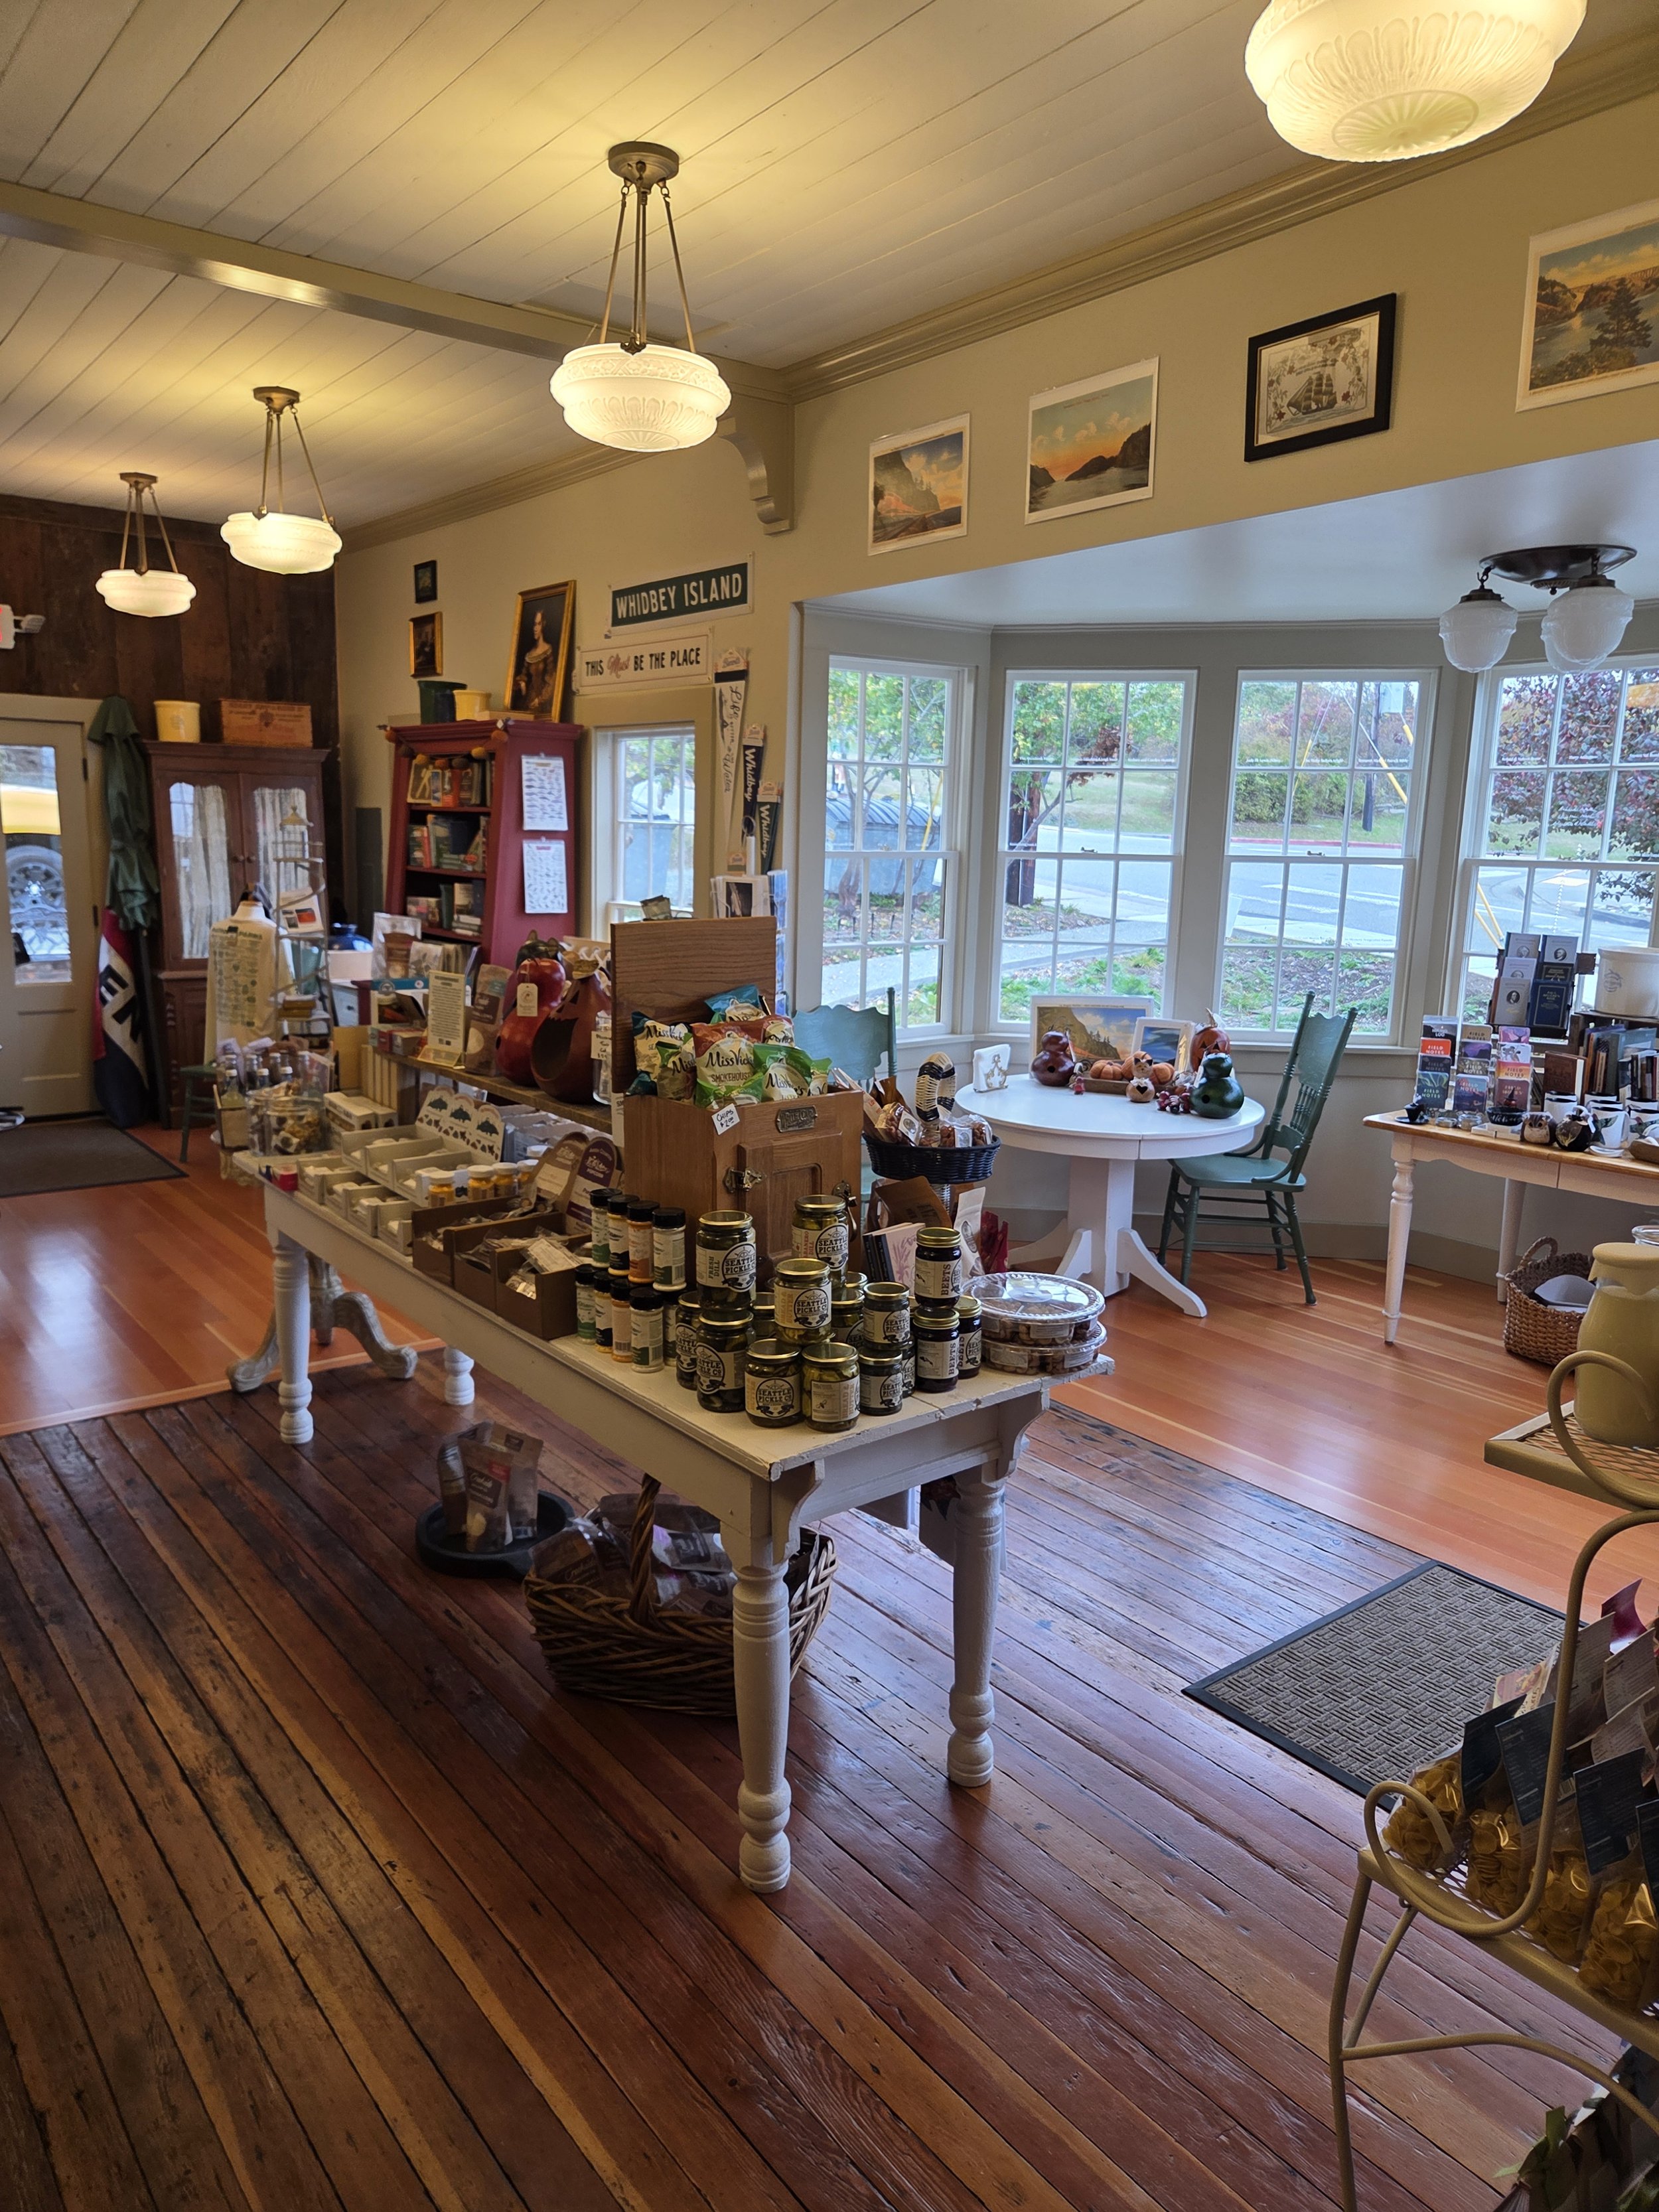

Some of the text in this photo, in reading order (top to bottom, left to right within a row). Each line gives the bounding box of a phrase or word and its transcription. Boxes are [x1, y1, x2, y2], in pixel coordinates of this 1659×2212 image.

[616, 573, 742, 619] WHIDBEY ISLAND
[585, 660, 604, 676] THIS
[634, 654, 644, 672] BE
[649, 652, 666, 670] THE
[670, 647, 701, 668] PLACE
[744, 748, 757, 802] Whidbey
[759, 804, 770, 859] Whidbey
[717, 1109, 734, 1122] CHIPS
[941, 1264, 950, 1295] BEETS
[797, 1297, 827, 1307] SEATTLE
[758, 1386, 792, 1396] SEATTLE
[758, 1394, 784, 1403] PICKLE
